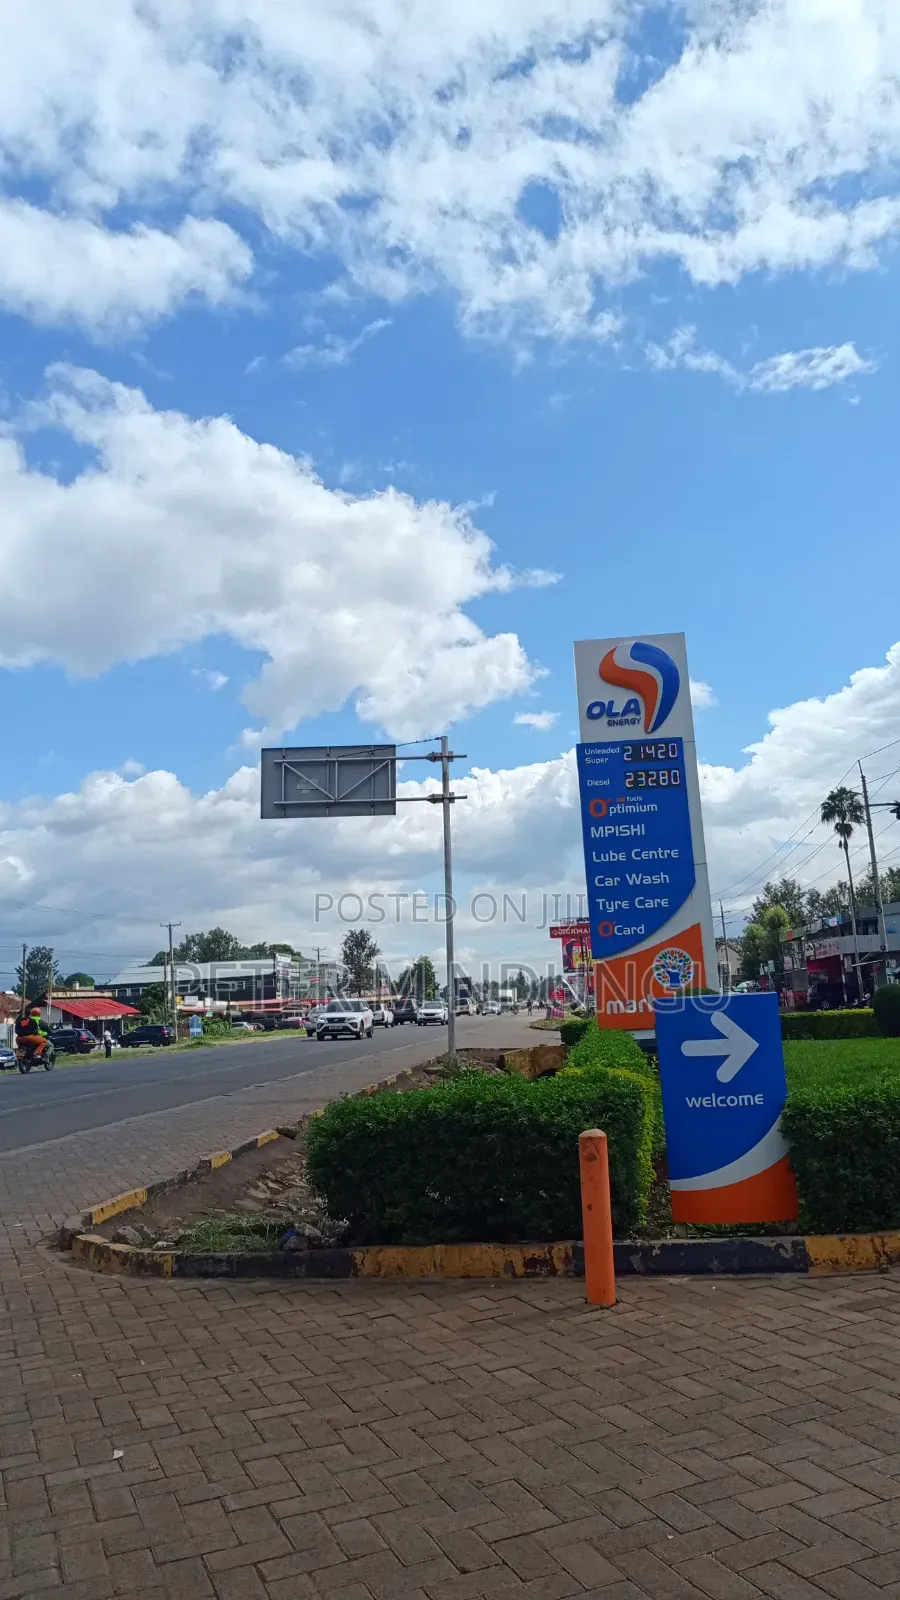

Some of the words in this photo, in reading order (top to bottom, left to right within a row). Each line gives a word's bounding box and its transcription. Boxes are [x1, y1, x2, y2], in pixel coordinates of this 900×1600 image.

[586, 698, 641, 720] OLA
[607, 717, 641, 727] ENERGY
[584, 747, 620, 756] Unleaded
[623, 743, 678, 761] 21420
[585, 757, 609, 765] Super
[587, 779, 610, 787] Diesel
[625, 769, 680, 788] 23280
[590, 824, 646, 838] MPISHI
[592, 851, 627, 863] Lube
[631, 847, 679, 861] Centre
[594, 875, 621, 887] Car
[625, 872, 670, 886] Wash
[596, 898, 630, 912] Tyre
[634, 896, 669, 909] Care
[551, 928, 591, 936] QUICKMA
[685, 1093, 764, 1108] welcome
